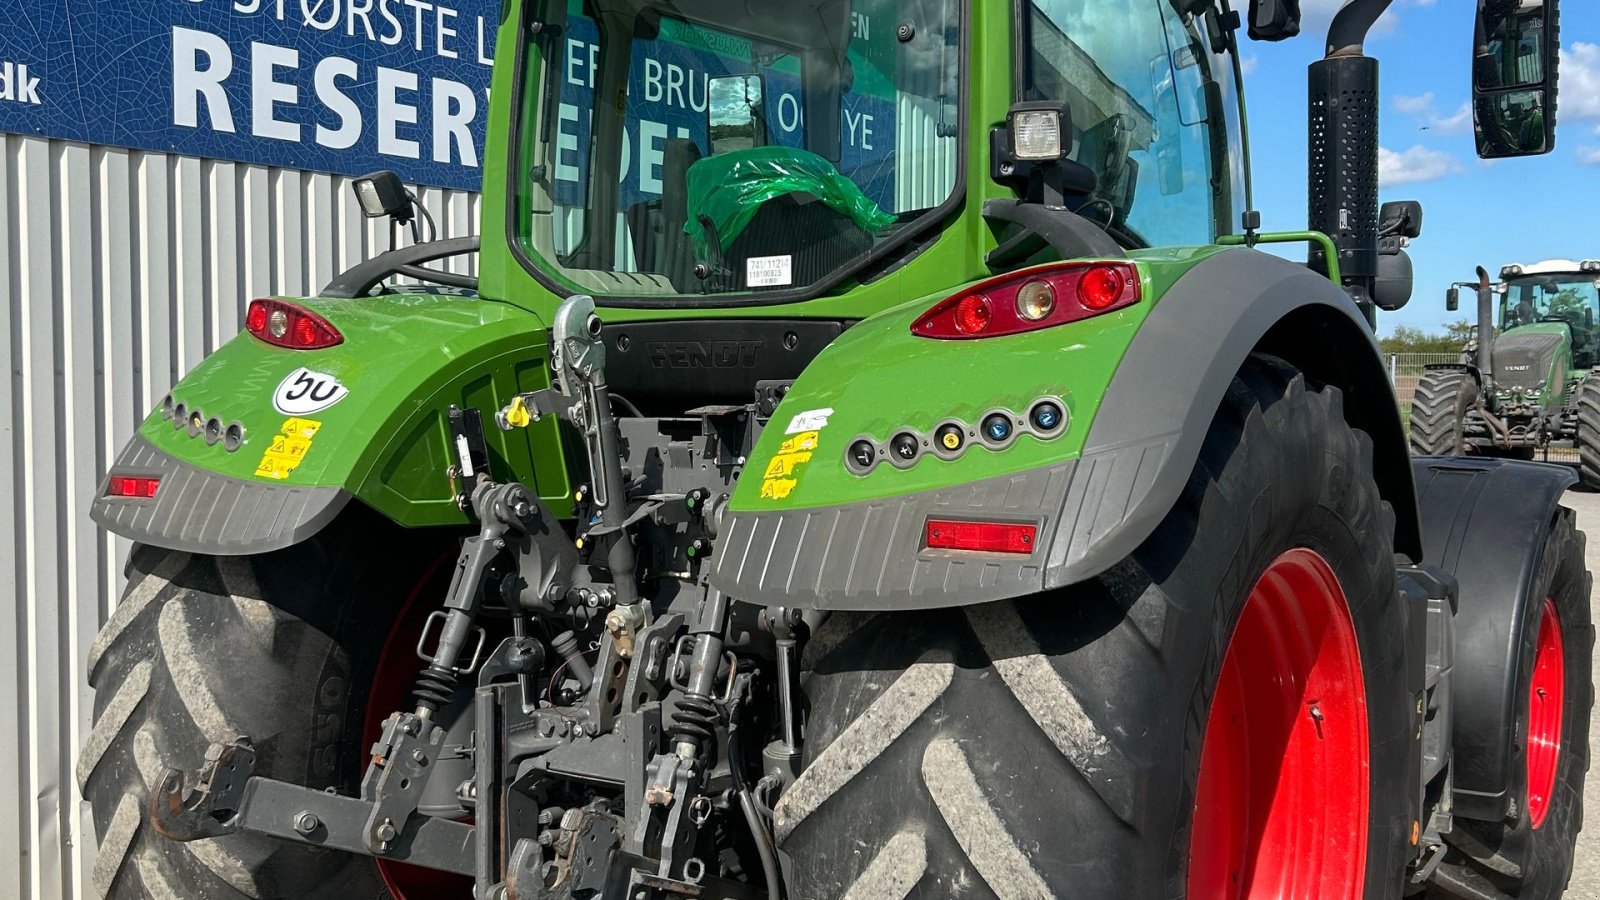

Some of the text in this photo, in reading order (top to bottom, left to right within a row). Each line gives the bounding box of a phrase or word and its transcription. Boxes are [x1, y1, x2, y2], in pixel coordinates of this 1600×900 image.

[172, 25, 481, 168] RESER
[234, 0, 458, 59] ØRSTE
[645, 58, 709, 113] BRU
[844, 109, 874, 151] YE
[646, 340, 764, 369] FENDT
